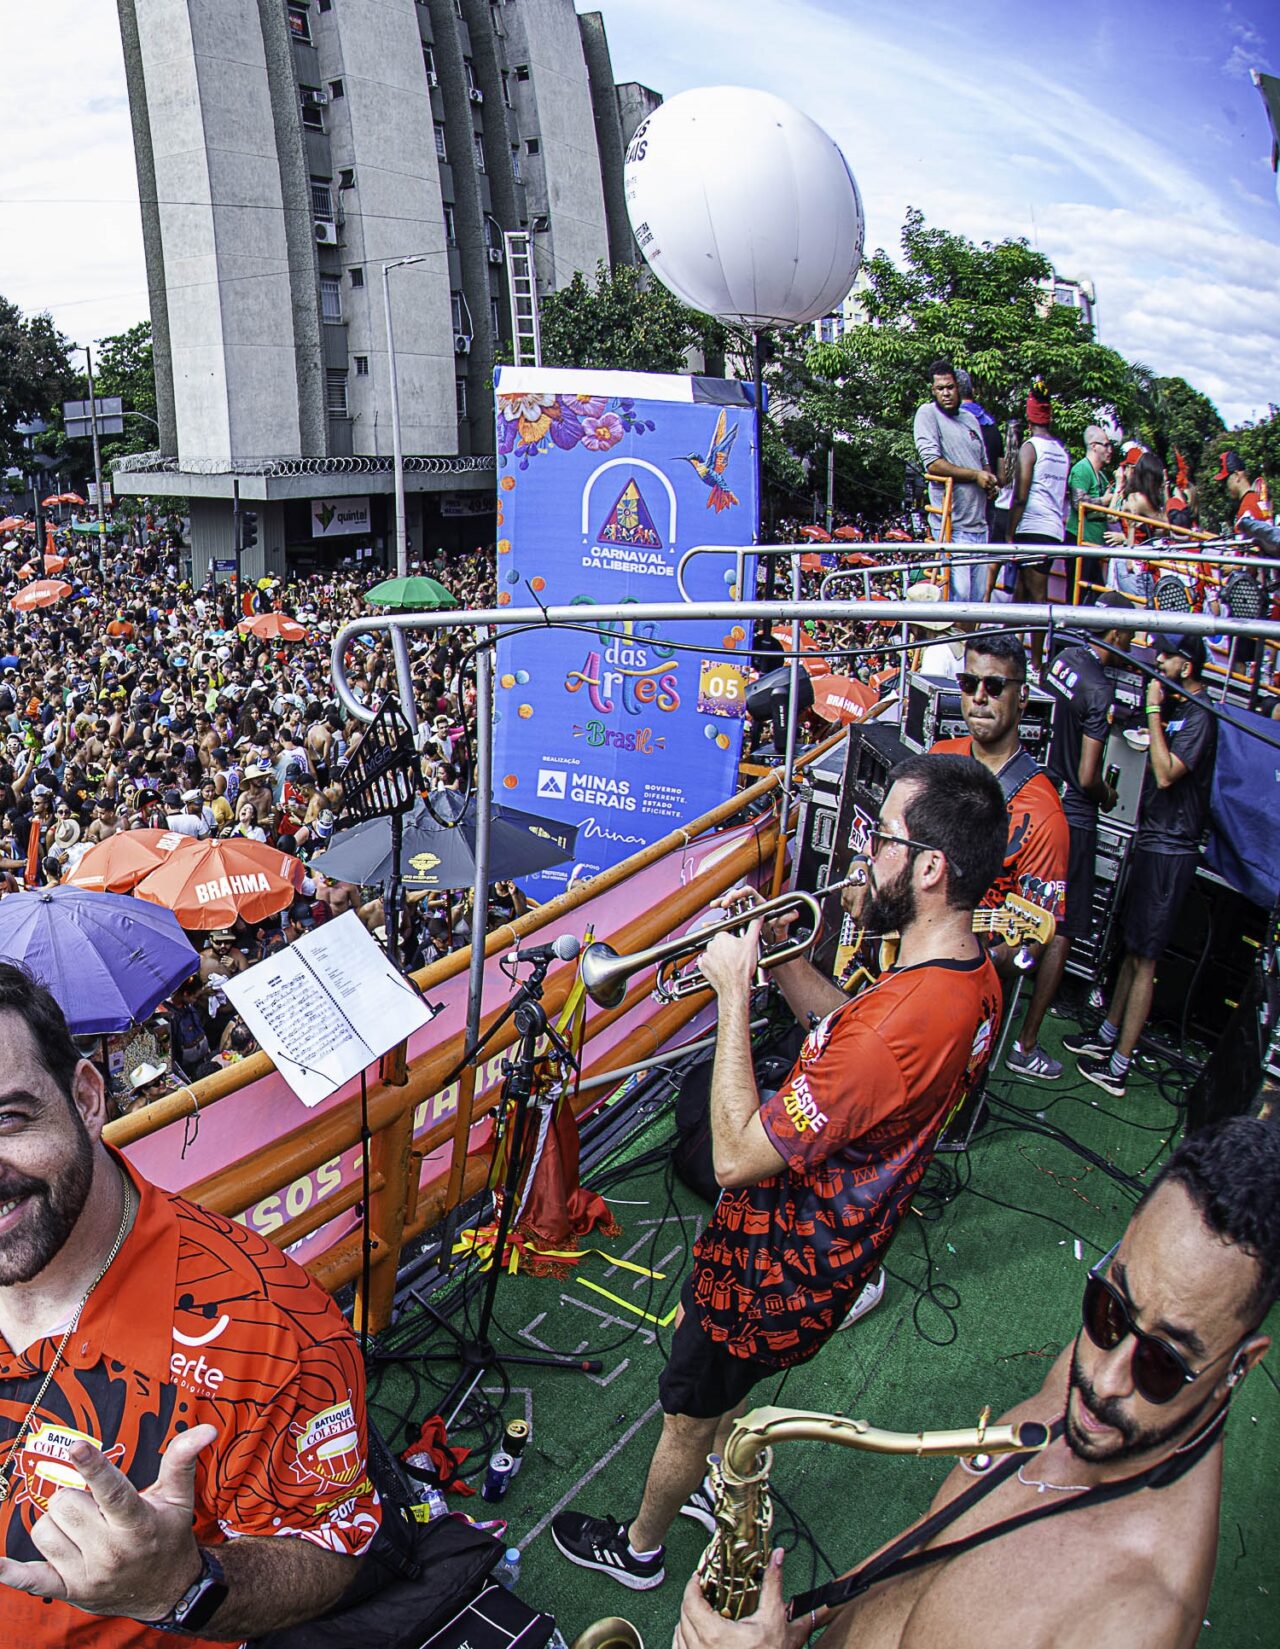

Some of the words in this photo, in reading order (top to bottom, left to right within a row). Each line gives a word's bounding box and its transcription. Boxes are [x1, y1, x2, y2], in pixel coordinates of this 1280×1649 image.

[337, 508, 367, 524] quintal
[582, 557, 602, 568] DA
[603, 558, 675, 576] LIBERDADE
[590, 547, 666, 564] CARNAVAL
[604, 634, 647, 667] das
[565, 651, 680, 716] Artes
[709, 677, 739, 699] 05
[825, 693, 864, 717] BRAHMA
[585, 719, 653, 755] Brasil
[542, 755, 581, 765] REALIZAÇÃO
[571, 773, 631, 794] MINAS
[644, 784, 682, 794] GOVERNO
[570, 787, 637, 811] GERAIS
[642, 800, 673, 809] ESTADO
[643, 792, 688, 804] DIFERENTE.
[641, 807, 684, 818] EFICIENTE.
[576, 817, 646, 845] Minas
[195, 872, 271, 905] BRAHMA
[783, 1090, 811, 1133] 2013
[790, 1073, 829, 1133] DESDE
[315, 1407, 351, 1430] BATUQUE
[306, 1416, 356, 1446] COLETIV
[328, 1497, 358, 1523] 2017
